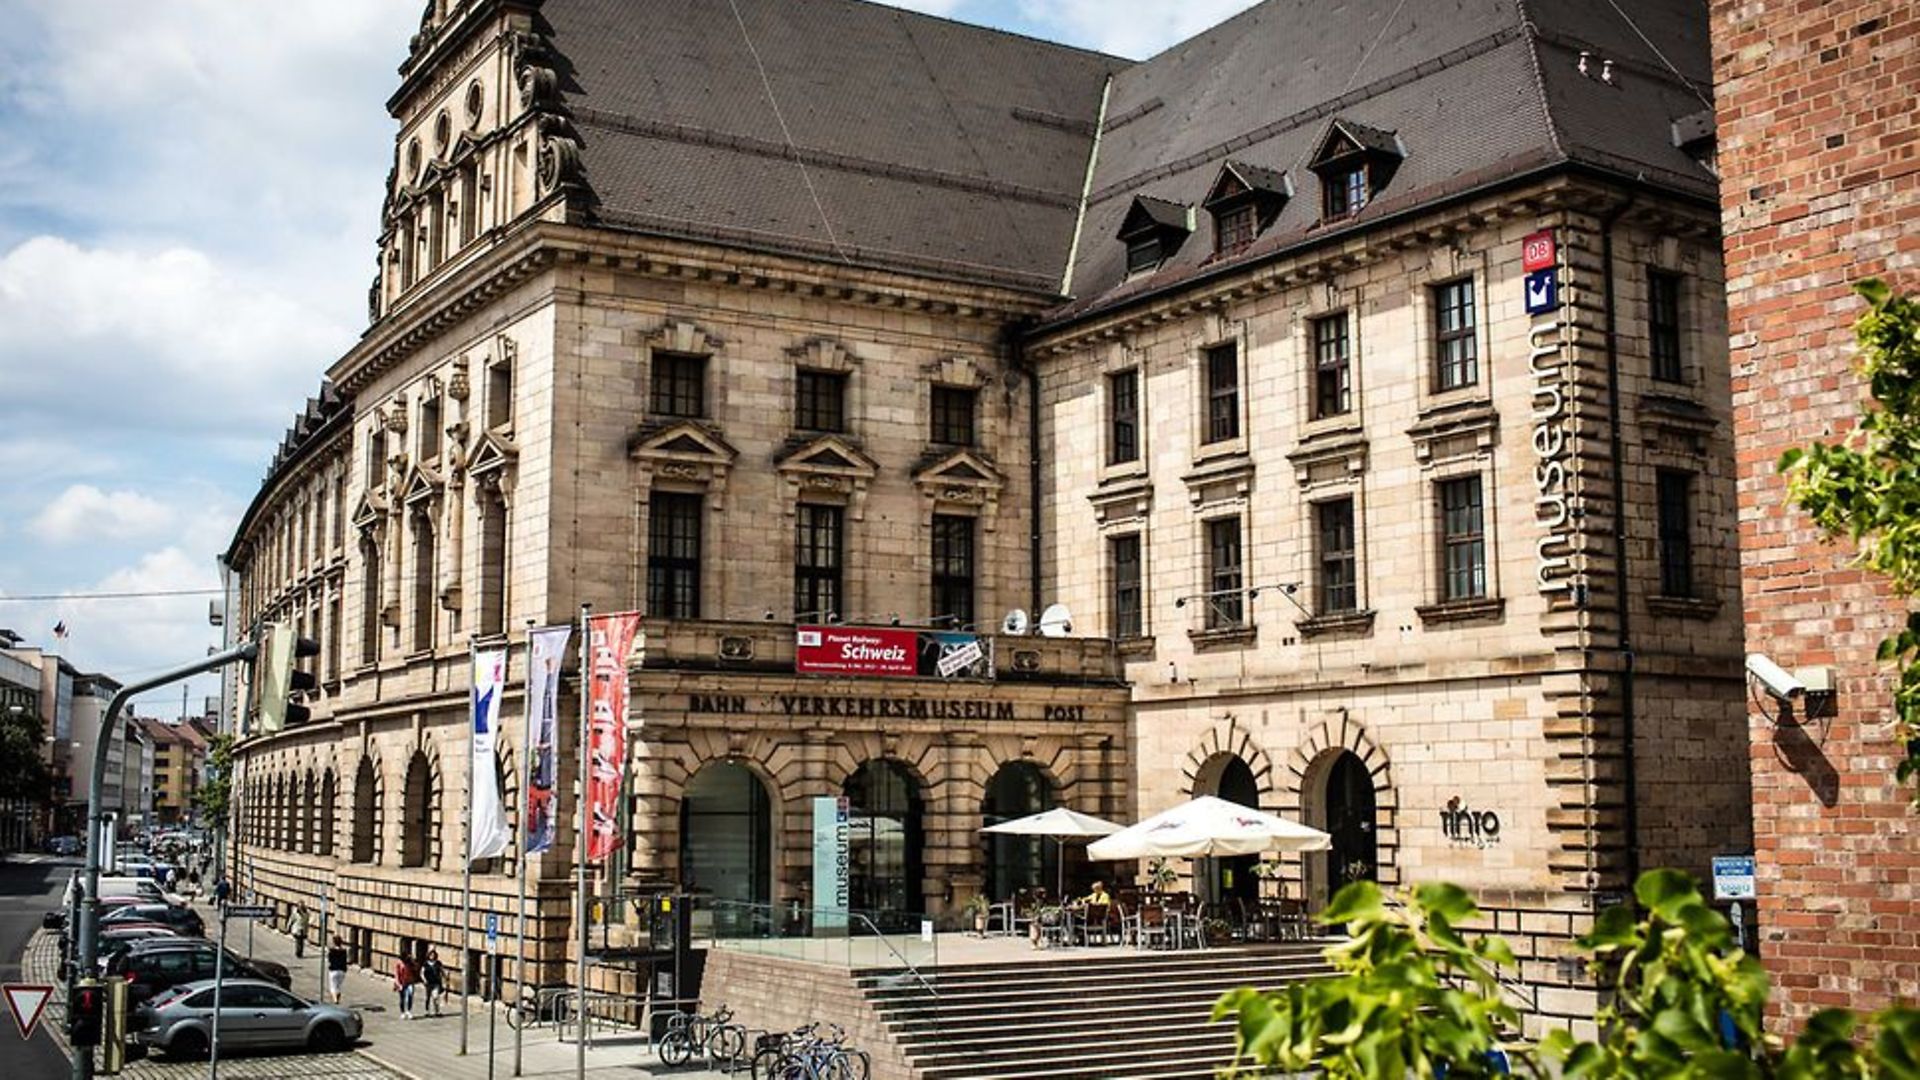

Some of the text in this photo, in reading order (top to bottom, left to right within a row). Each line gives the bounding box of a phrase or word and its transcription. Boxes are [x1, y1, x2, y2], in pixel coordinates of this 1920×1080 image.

[1527, 241, 1549, 262] DB
[1528, 322, 1570, 592] museum
[841, 643, 906, 661] Schweiz
[689, 695, 1085, 721] BAHN VERKEHRSMUSEUM POST
[836, 825, 849, 907] museum
